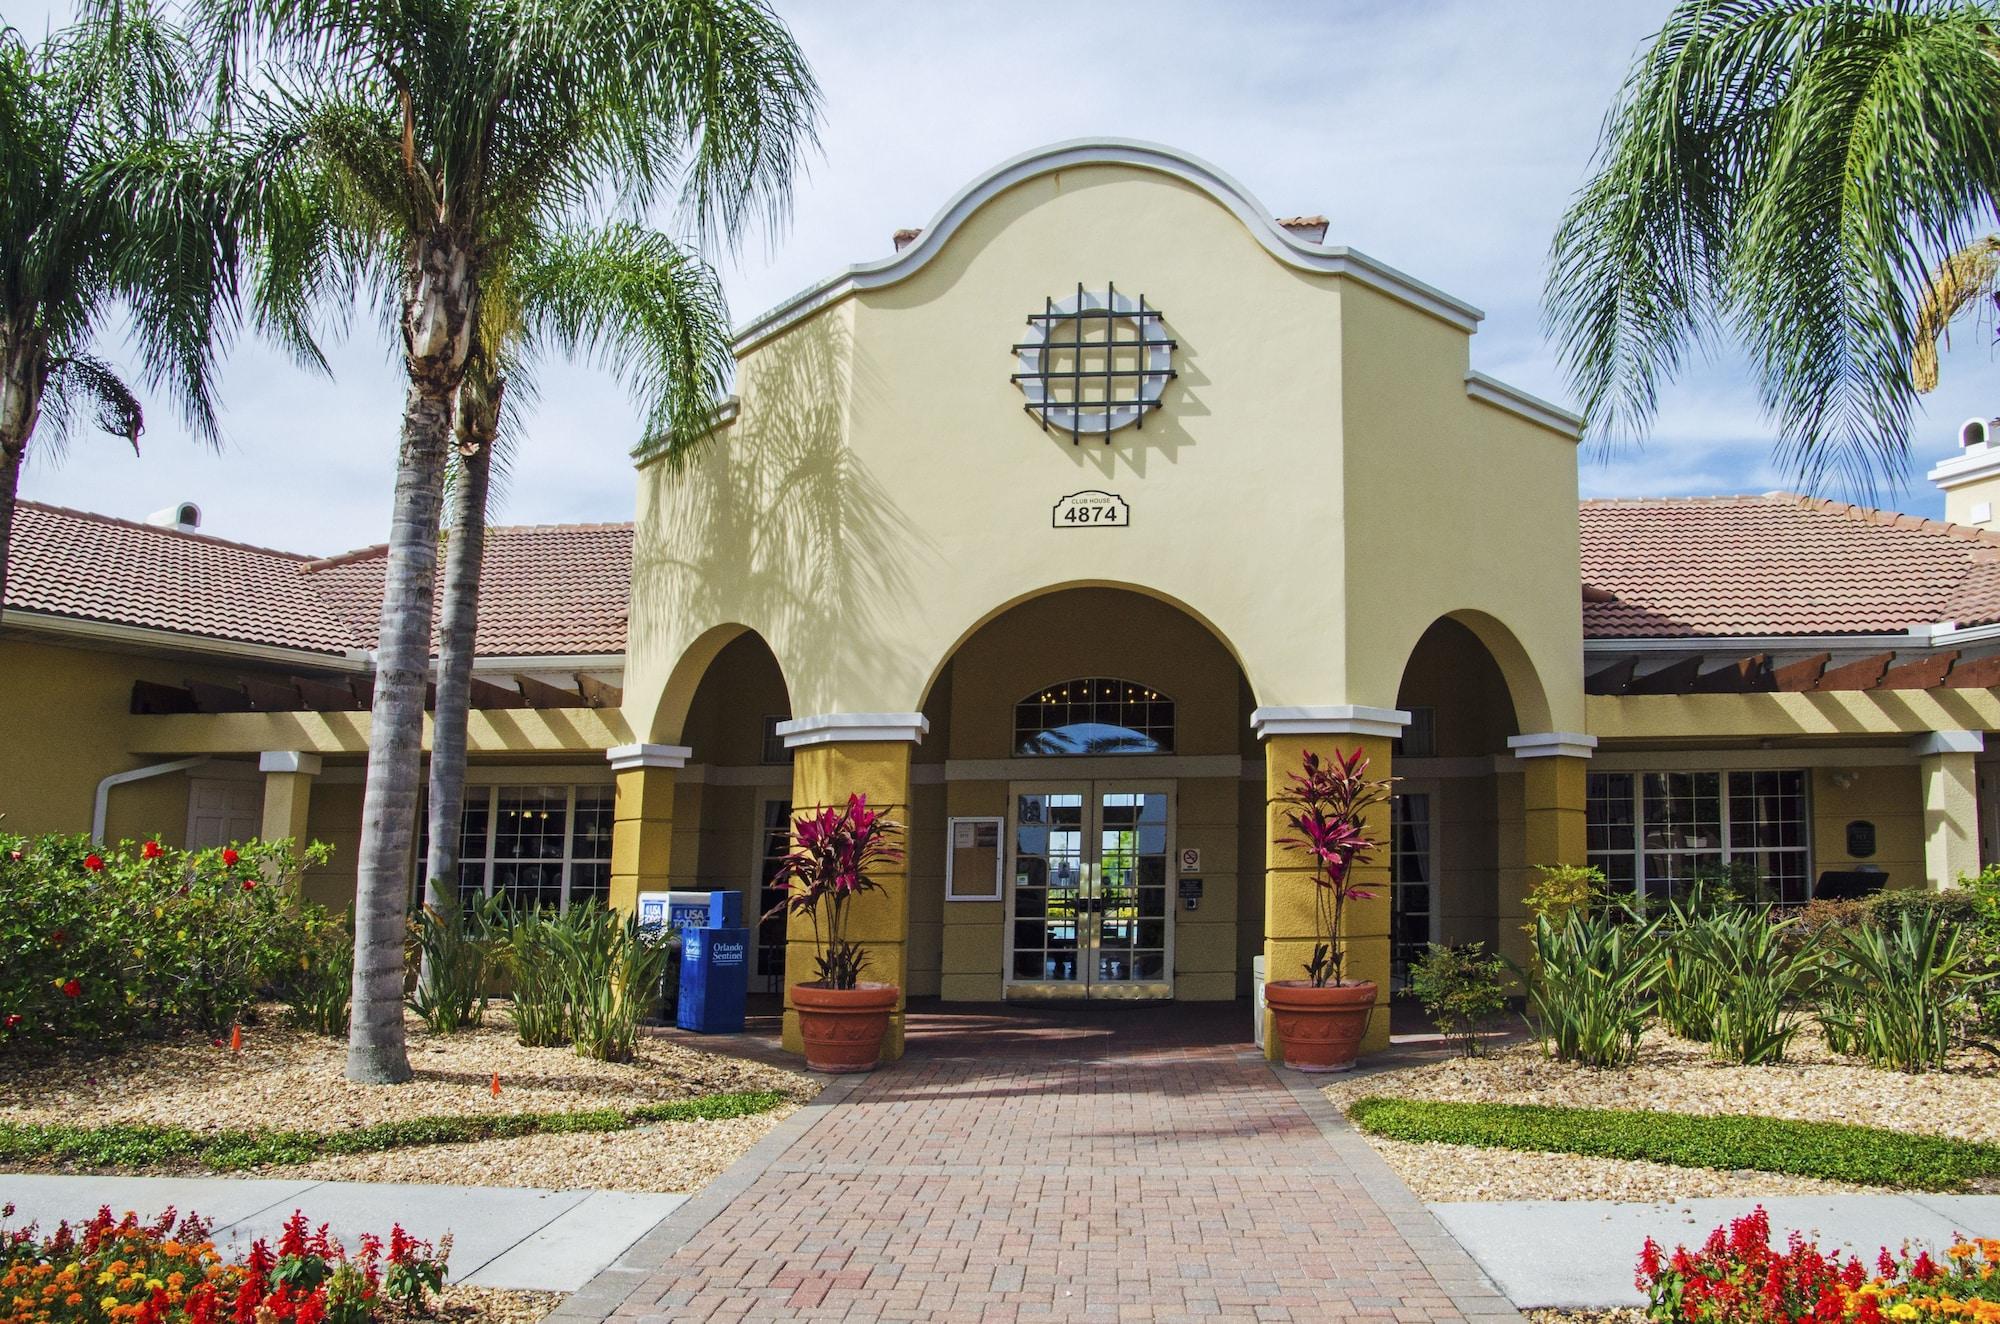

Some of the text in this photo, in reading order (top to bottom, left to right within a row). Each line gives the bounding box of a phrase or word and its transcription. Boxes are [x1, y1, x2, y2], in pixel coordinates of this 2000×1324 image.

[1064, 506, 1117, 522] 4874
[684, 910, 704, 919] USA
[673, 919, 705, 928] TODAY
[713, 943, 743, 951] Orlando
[712, 951, 743, 960] Sentinel
